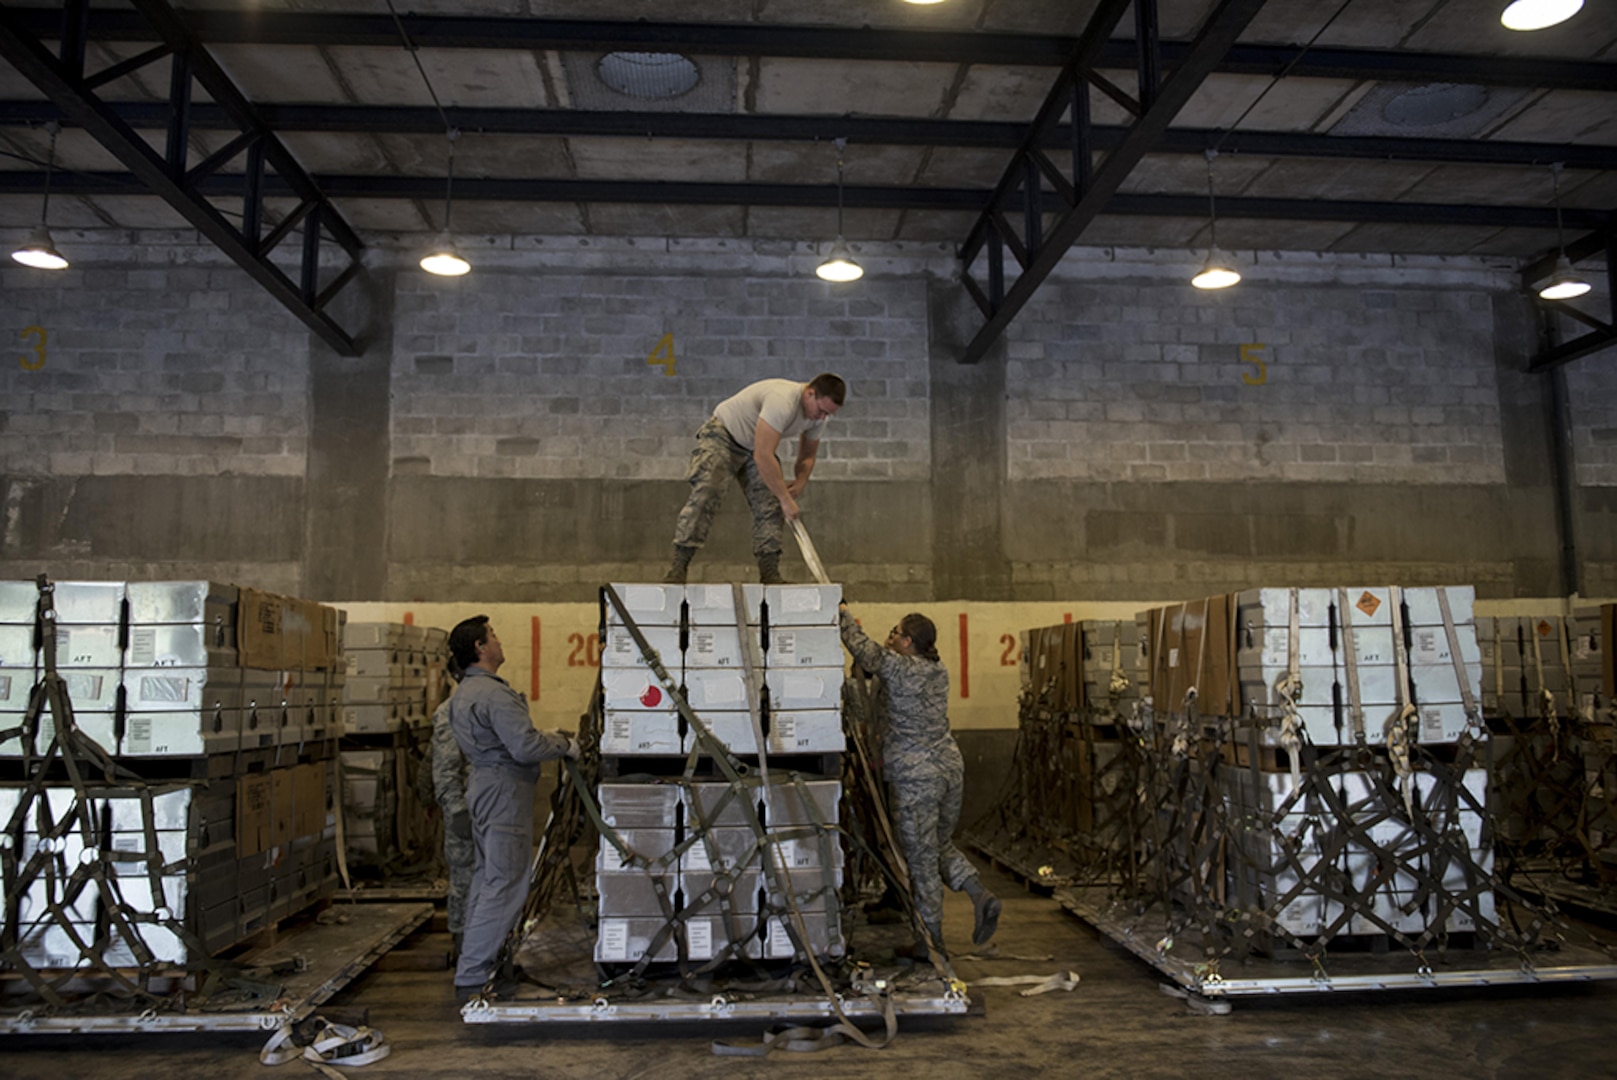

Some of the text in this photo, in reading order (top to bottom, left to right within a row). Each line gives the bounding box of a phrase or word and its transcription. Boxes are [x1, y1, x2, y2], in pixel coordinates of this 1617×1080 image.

[19, 325, 46, 370] 3
[646, 332, 677, 377] 4
[1239, 343, 1267, 386] 5
[718, 657, 730, 665] AFT
[999, 633, 1022, 667] 2
